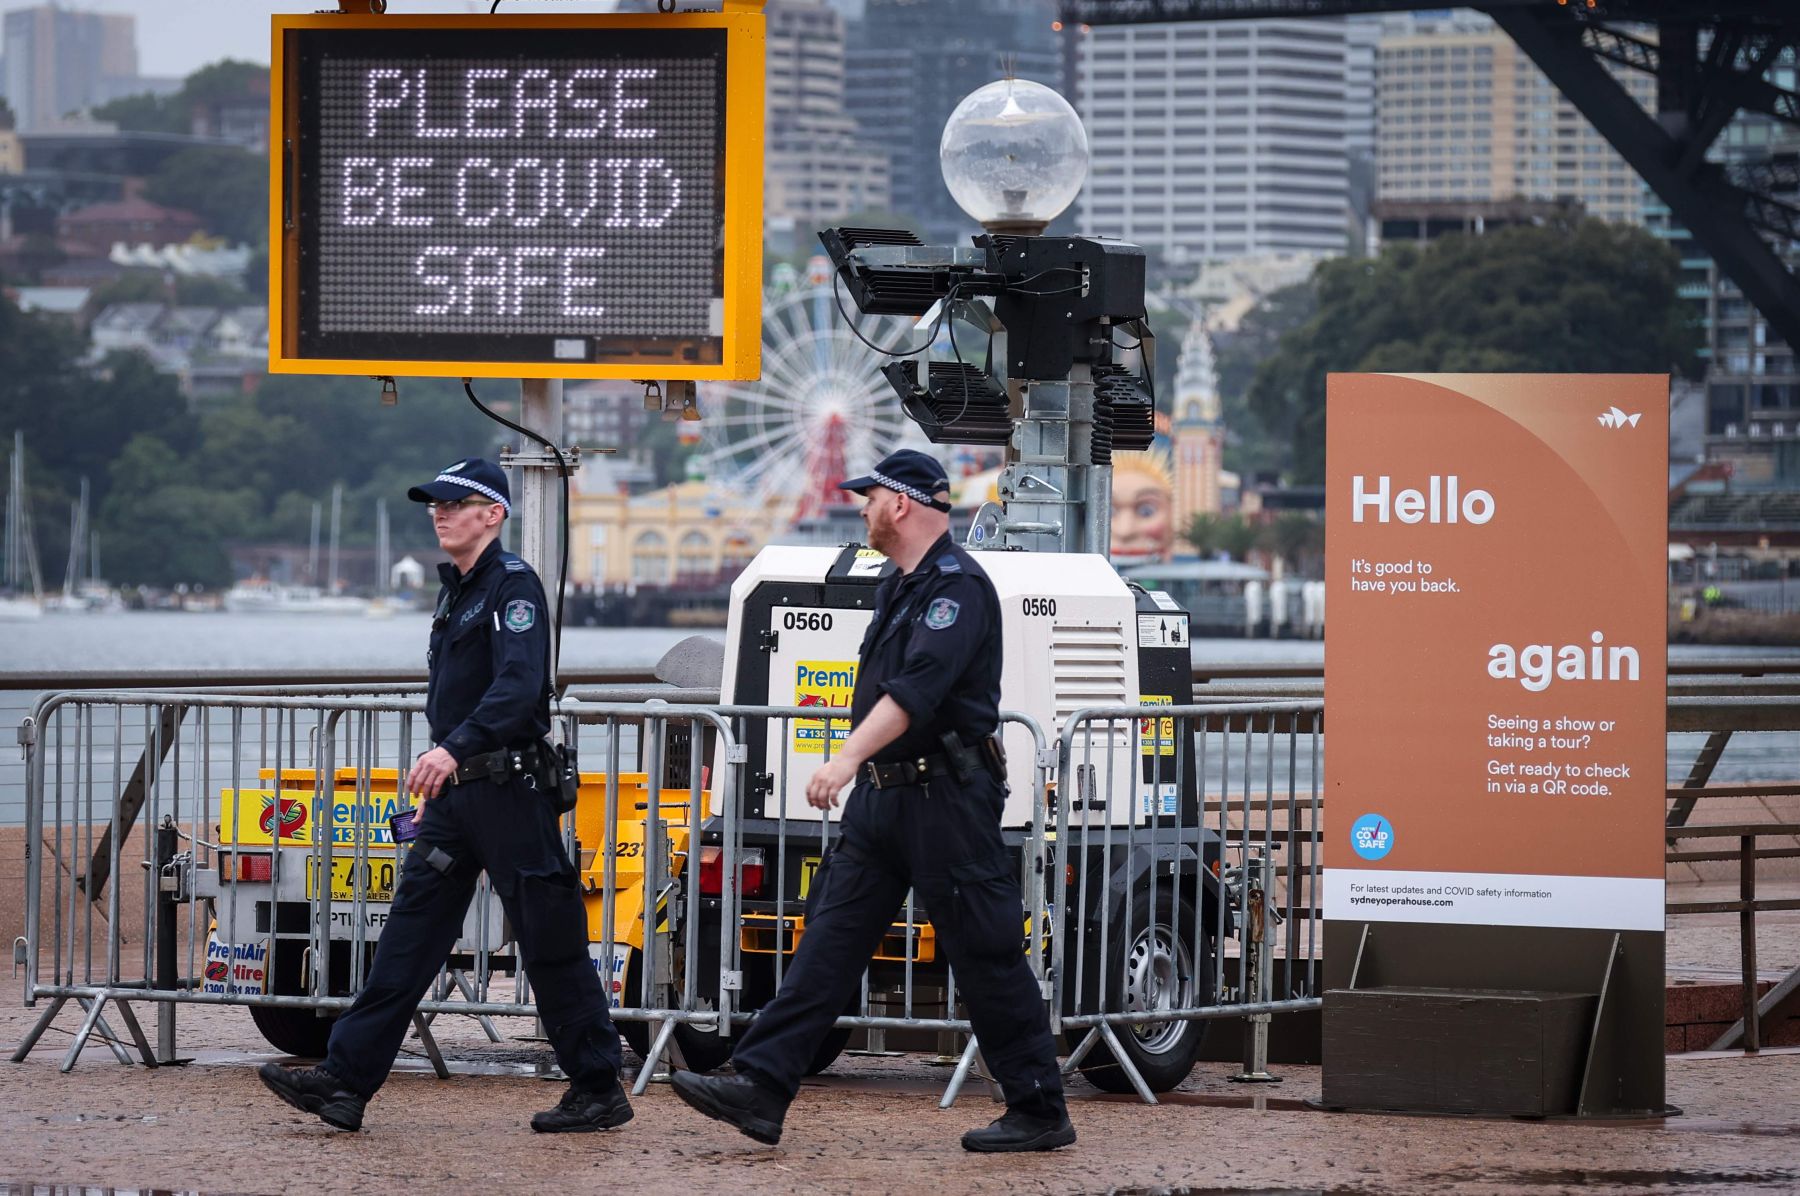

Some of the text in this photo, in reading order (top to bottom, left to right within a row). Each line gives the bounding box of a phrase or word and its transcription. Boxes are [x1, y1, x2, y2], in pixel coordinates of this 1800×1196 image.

[368, 69, 657, 138] PLEASE
[343, 157, 682, 228] BE COVID
[415, 246, 606, 316] SAFE
[1352, 475, 1496, 525] Hello
[1351, 558, 1432, 577] It's good to
[1352, 576, 1461, 595] have you back.
[1022, 597, 1057, 617] 0560
[783, 611, 833, 632] 0560
[1487, 630, 1641, 692] again
[797, 665, 854, 688] Premi
[1487, 714, 1616, 733] Seeing a show or
[1487, 732, 1591, 751] taking a tour?
[1487, 760, 1630, 779] Get ready to check
[1487, 778, 1612, 796] in via a QR code.
[1355, 830, 1389, 840] COVID
[1359, 839, 1386, 849] SAFE
[1350, 883, 1552, 899] For latest updates and COVID safety information
[1350, 896, 1454, 907] sydneyoperahouse.com
